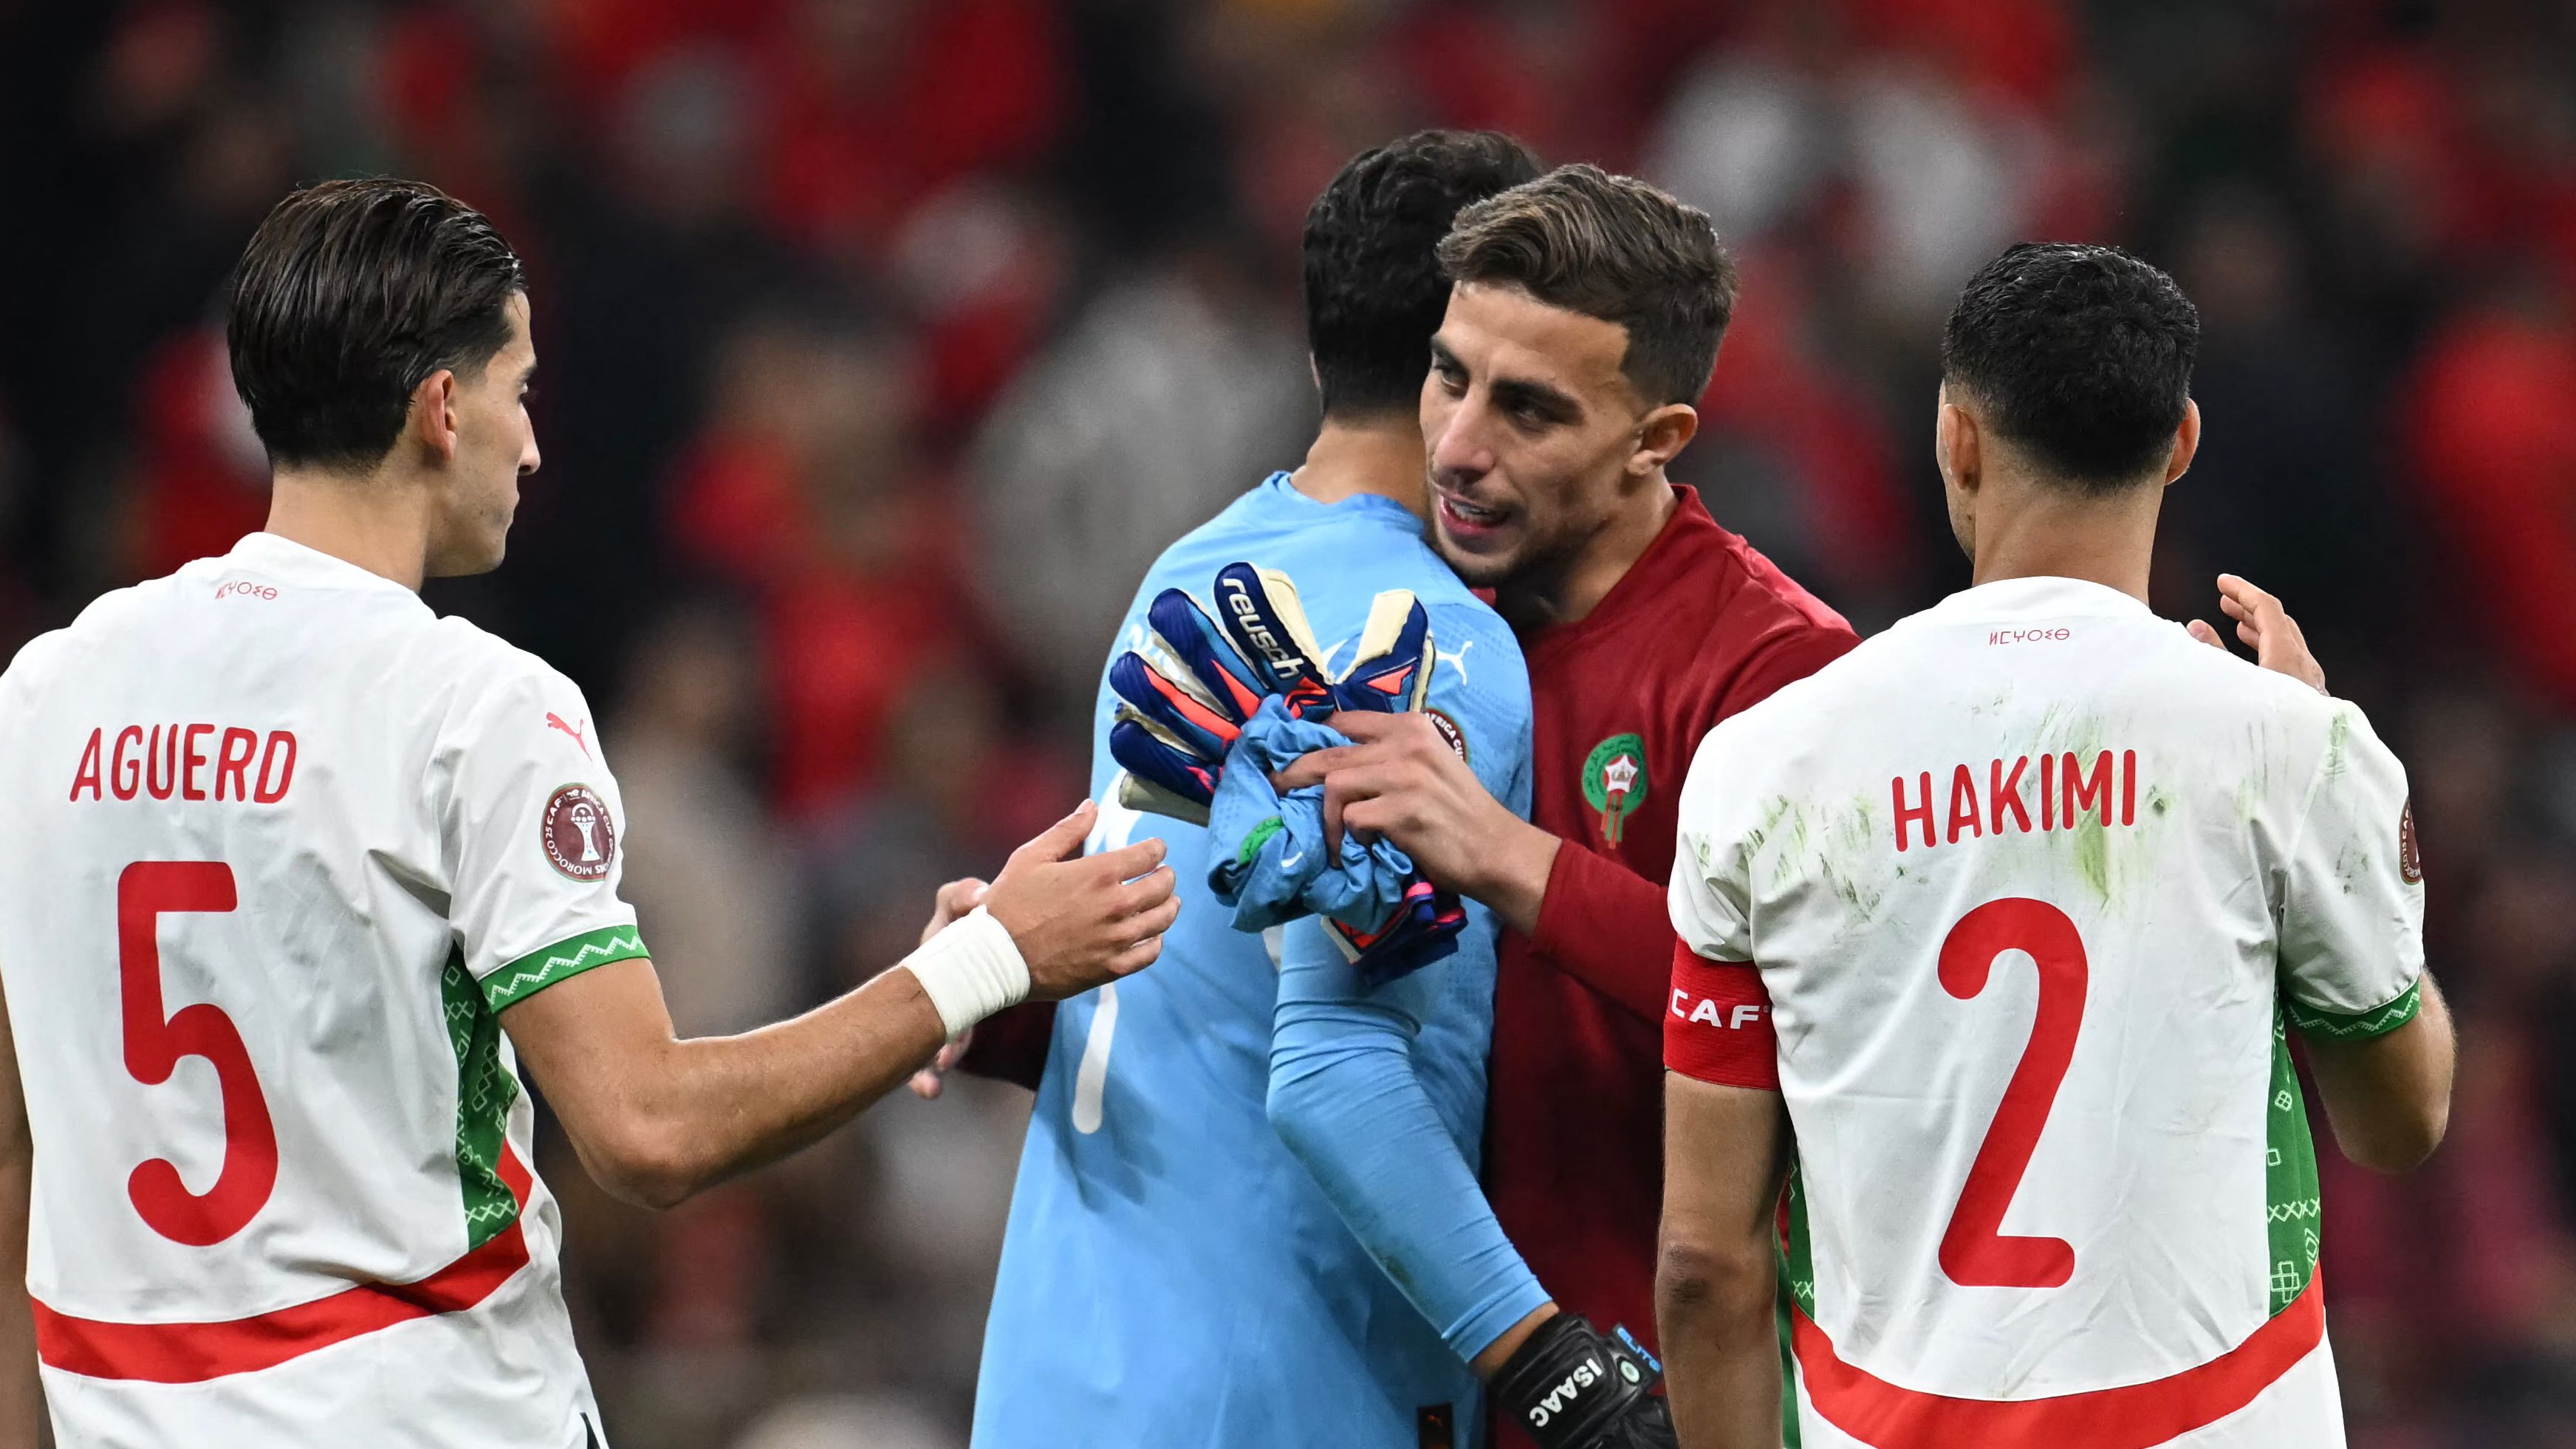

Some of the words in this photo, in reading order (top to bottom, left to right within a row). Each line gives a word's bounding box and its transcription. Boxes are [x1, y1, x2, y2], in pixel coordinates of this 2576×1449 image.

[1223, 578, 1304, 679] reusch
[69, 723, 297, 804] AGUERD
[1453, 739, 1464, 758] CU
[545, 826, 553, 838] 25
[547, 797, 563, 826] CAF
[1891, 749, 2137, 852] HAKIMI
[547, 840, 592, 875] MOROCCO
[1671, 987, 1760, 1030] CAF
[117, 860, 278, 1247] 5
[1937, 897, 2089, 1288] 2
[1529, 1357, 1603, 1427] ISAAC
